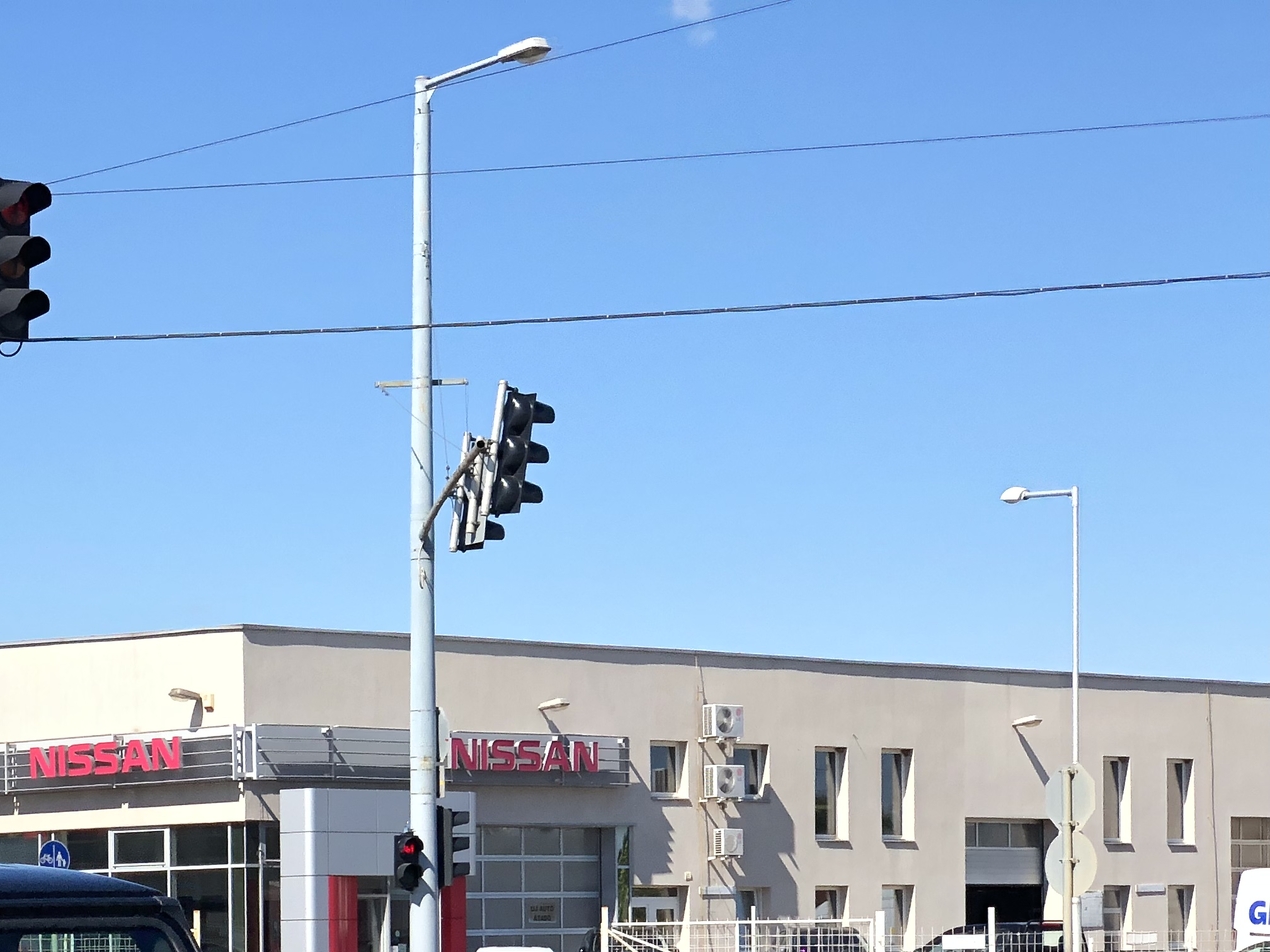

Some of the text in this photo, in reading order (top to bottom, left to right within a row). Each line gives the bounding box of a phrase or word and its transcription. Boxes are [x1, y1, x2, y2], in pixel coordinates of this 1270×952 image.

[30, 736, 183, 779] NISSAN
[450, 738, 599, 772] NISSAN
[1249, 900, 1270, 926] G
